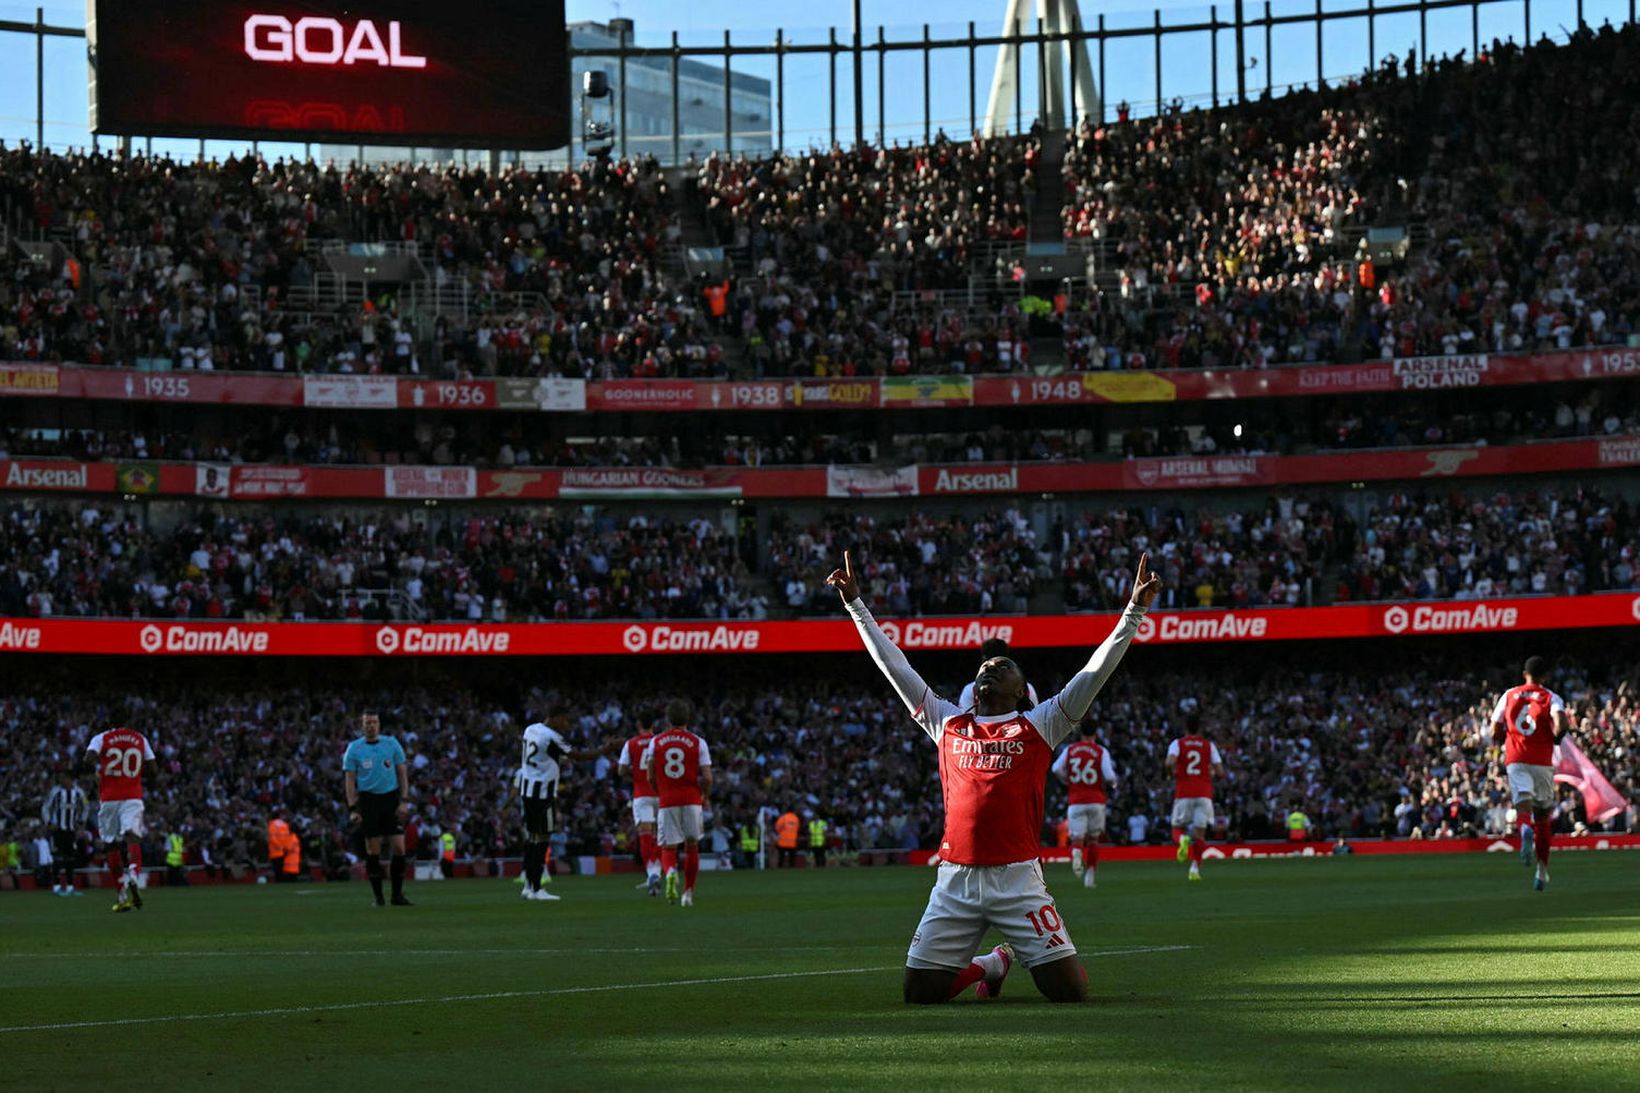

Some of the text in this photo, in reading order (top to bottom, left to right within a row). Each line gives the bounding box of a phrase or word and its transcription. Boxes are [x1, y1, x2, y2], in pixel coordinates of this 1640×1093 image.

[244, 14, 427, 68] GOAL
[1400, 356, 1483, 372] ARSENAL
[144, 377, 190, 398] 1935
[1032, 380, 1081, 401] 1948
[1402, 372, 1479, 389] POLAND
[438, 385, 485, 405] 1936
[731, 386, 779, 405] 1938
[6, 461, 87, 489] Arsenal
[562, 470, 639, 486] HUNGARIAN
[935, 466, 1018, 492] Arsenal
[1160, 613, 1267, 640] ComAve
[1412, 604, 1518, 631] ComAve
[166, 626, 269, 652] ComAve
[403, 627, 510, 652] ComAve
[651, 625, 759, 651] ComAve
[904, 621, 1013, 647] ComAve
[1515, 703, 1537, 737] 6
[952, 737, 1024, 755] Emirates
[104, 747, 142, 778] 20
[664, 747, 685, 779] 8
[958, 755, 1012, 770] FLY BETTER
[1069, 757, 1098, 785] 36
[1186, 749, 1202, 775] 2
[1025, 905, 1061, 937] 10
